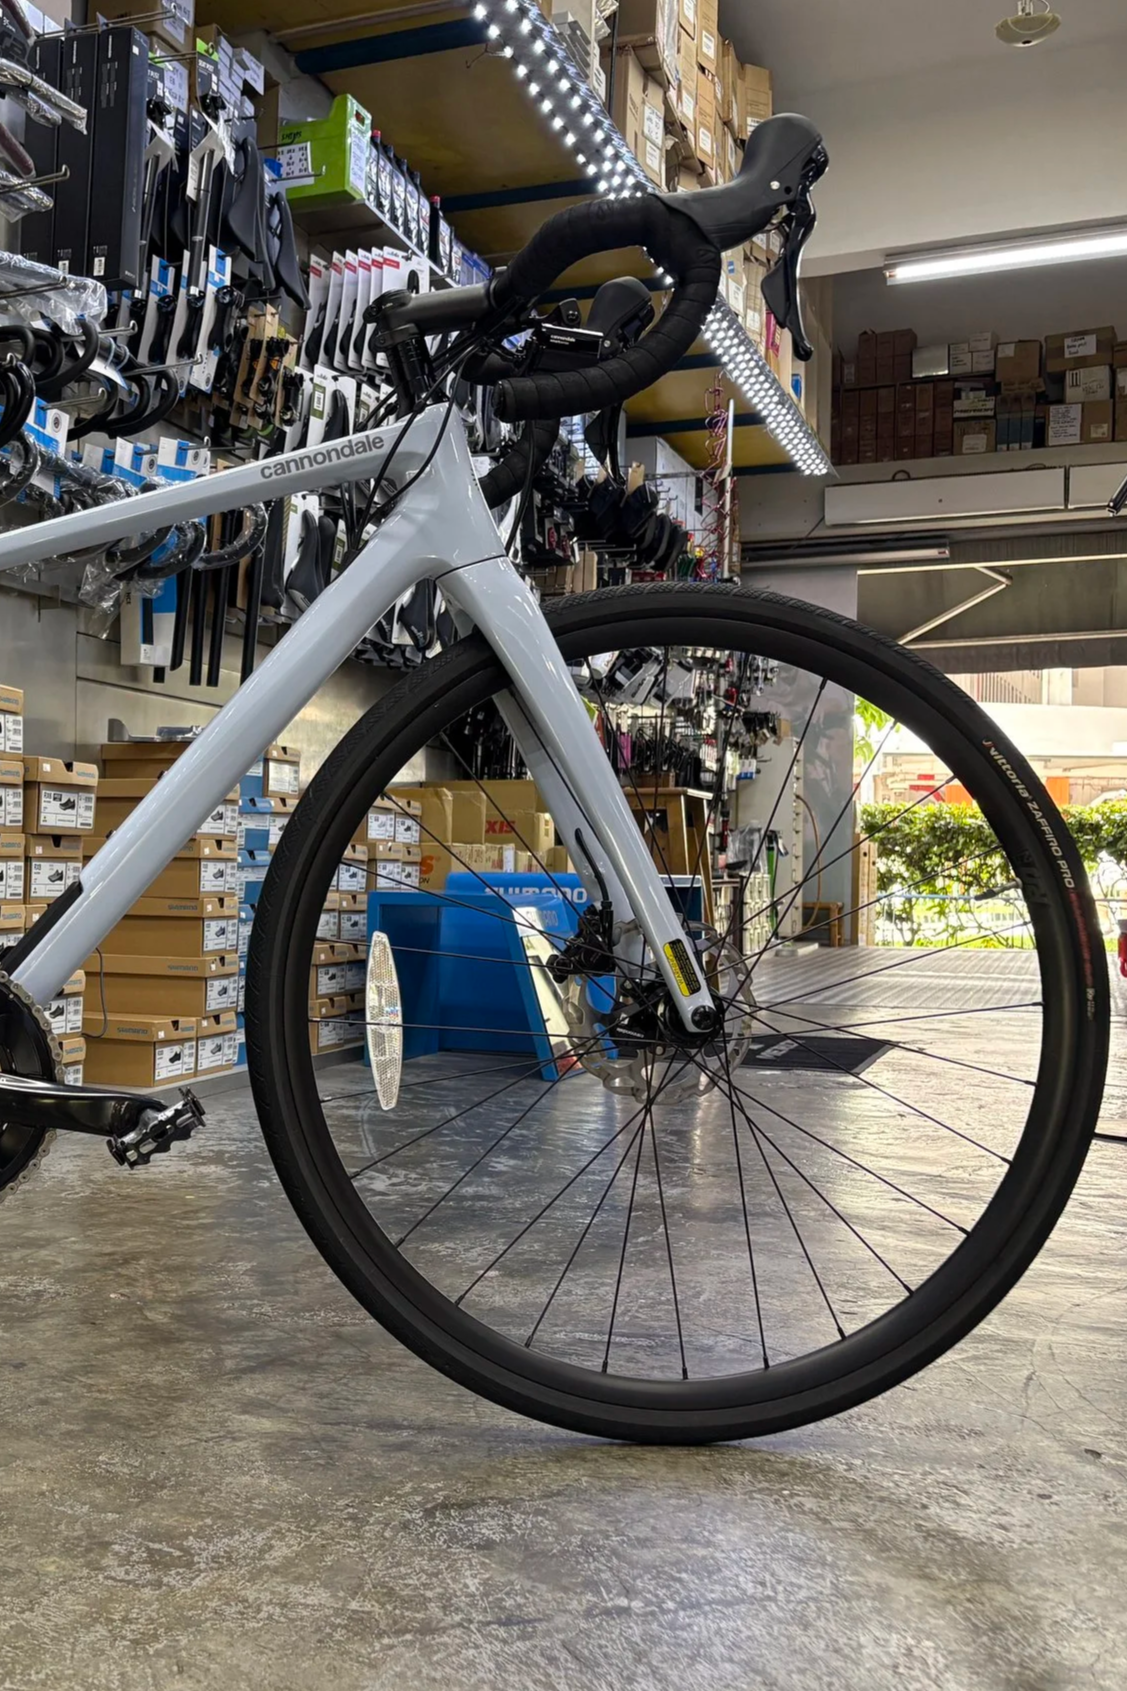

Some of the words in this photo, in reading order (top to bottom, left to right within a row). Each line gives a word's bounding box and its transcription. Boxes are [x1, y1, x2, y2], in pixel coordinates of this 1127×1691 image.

[260, 434, 385, 480] cannondale
[1027, 801, 1063, 857] ZAFFIRO
[1056, 859, 1075, 889] PRO
